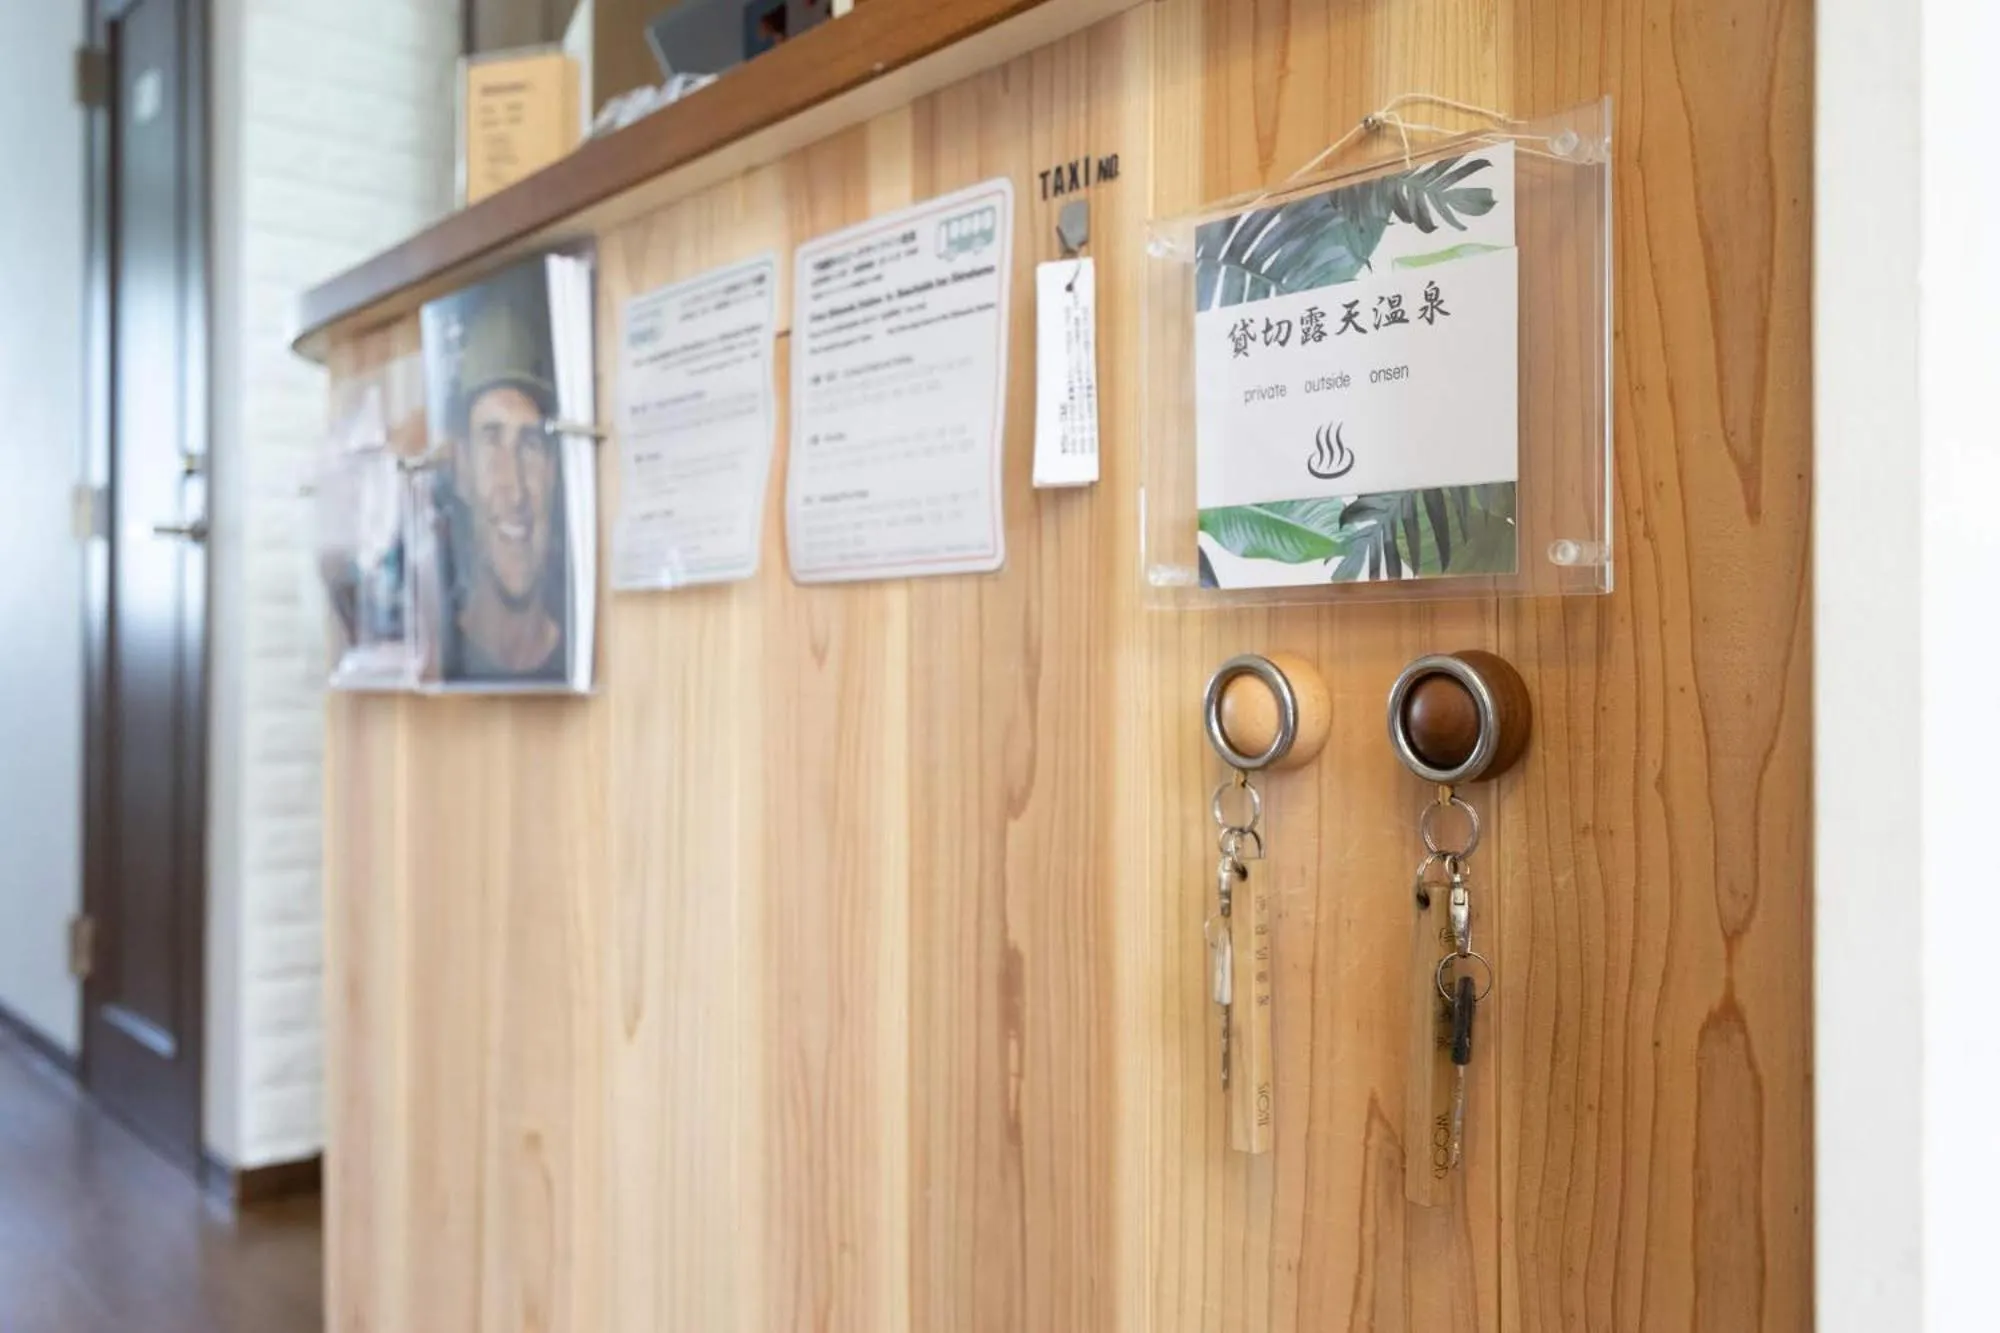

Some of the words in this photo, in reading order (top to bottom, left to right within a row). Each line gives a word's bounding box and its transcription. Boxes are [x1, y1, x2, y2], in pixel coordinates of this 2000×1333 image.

[1039, 156, 1090, 201] TAXI
[1228, 280, 1451, 358] 貸切露天温泉
[1244, 383, 1287, 404] private
[1304, 371, 1351, 394] outside
[1369, 364, 1409, 384] onsen
[1434, 1112, 1450, 1180] WOOD
